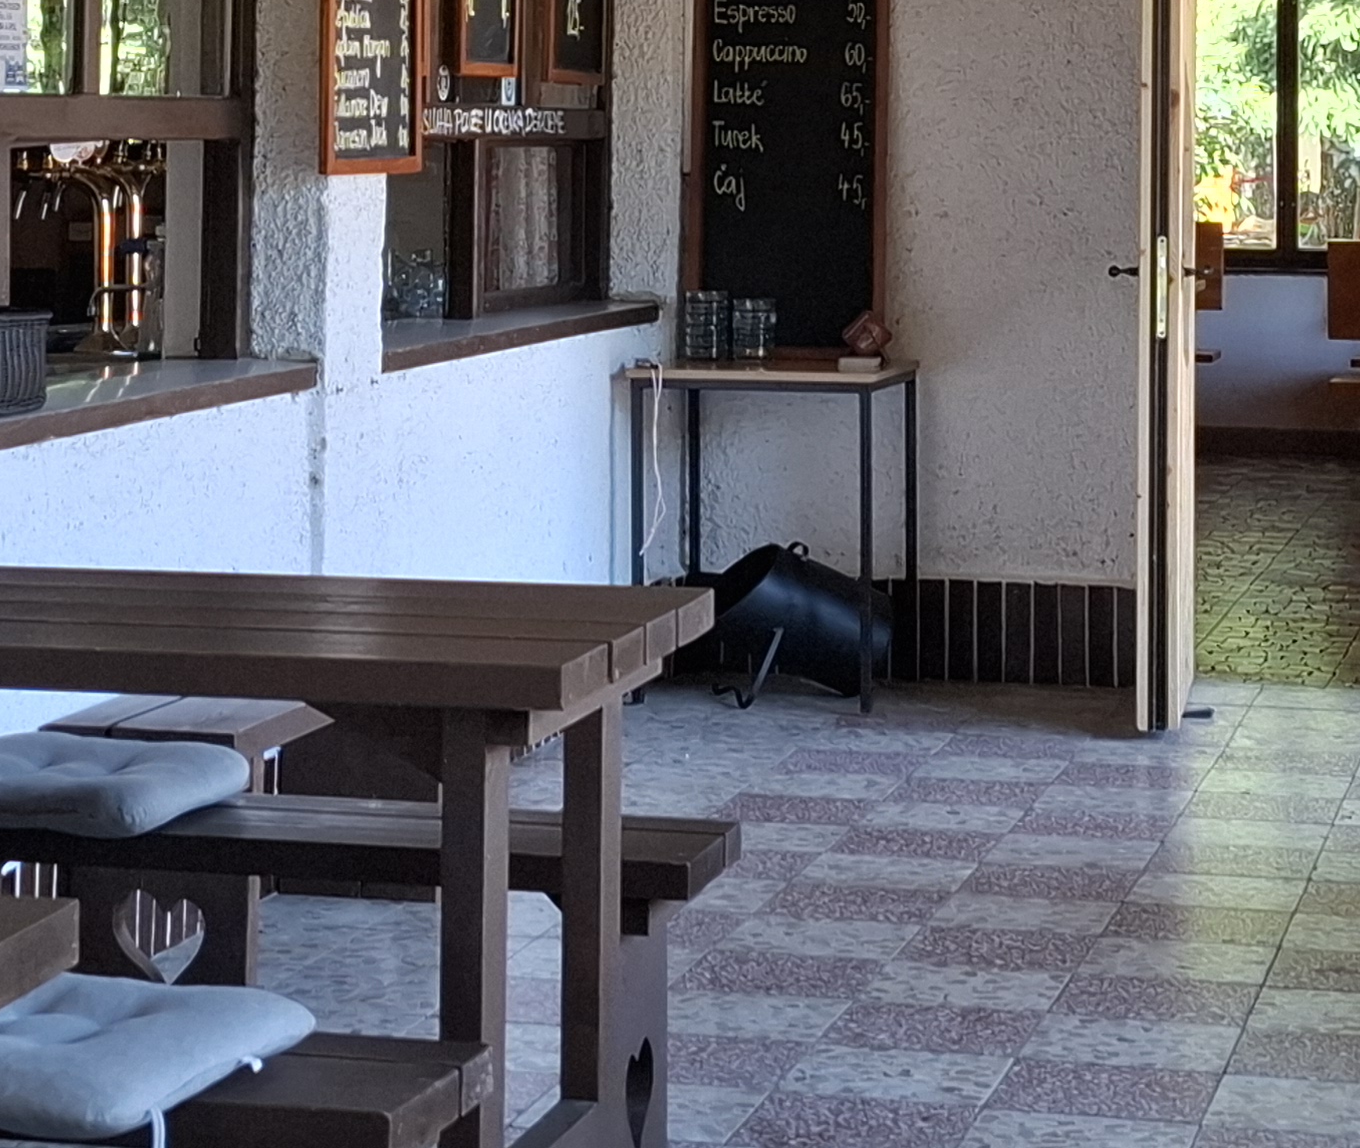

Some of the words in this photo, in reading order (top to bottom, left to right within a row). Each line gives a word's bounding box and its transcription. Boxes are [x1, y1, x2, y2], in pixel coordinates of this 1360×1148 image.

[713, 38, 807, 73] Cappuccino
[712, 120, 764, 152] Turek
[713, 163, 745, 211] Čaj
